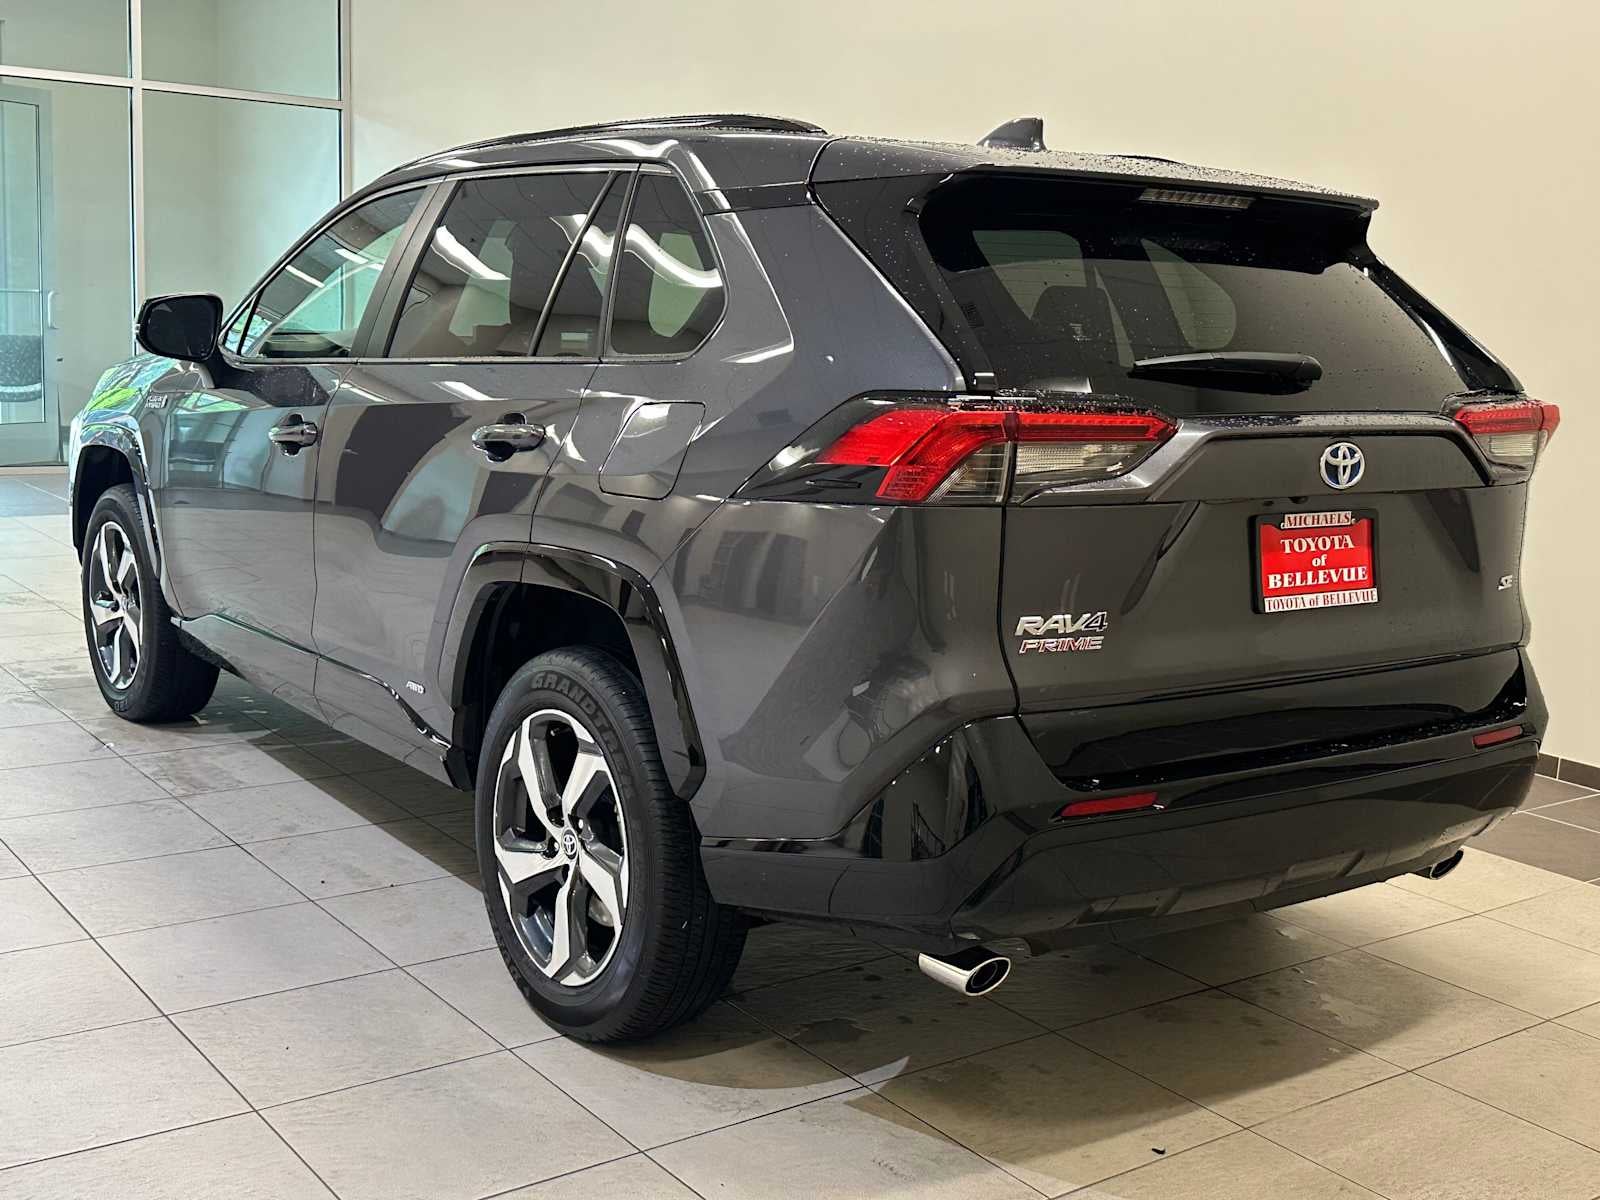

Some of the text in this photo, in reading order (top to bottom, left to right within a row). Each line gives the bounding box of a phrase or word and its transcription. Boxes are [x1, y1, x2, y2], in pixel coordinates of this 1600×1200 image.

[1285, 511, 1350, 527] MICHAELS
[1280, 534, 1355, 554] TOYOTA
[1311, 554, 1327, 567] of
[1267, 566, 1368, 589] BELLEVUE
[1498, 574, 1512, 591] SE
[1266, 589, 1377, 612] TOYOTA of BELLEVUE
[1015, 611, 1108, 636] RAV4
[1019, 636, 1104, 654] PRIME
